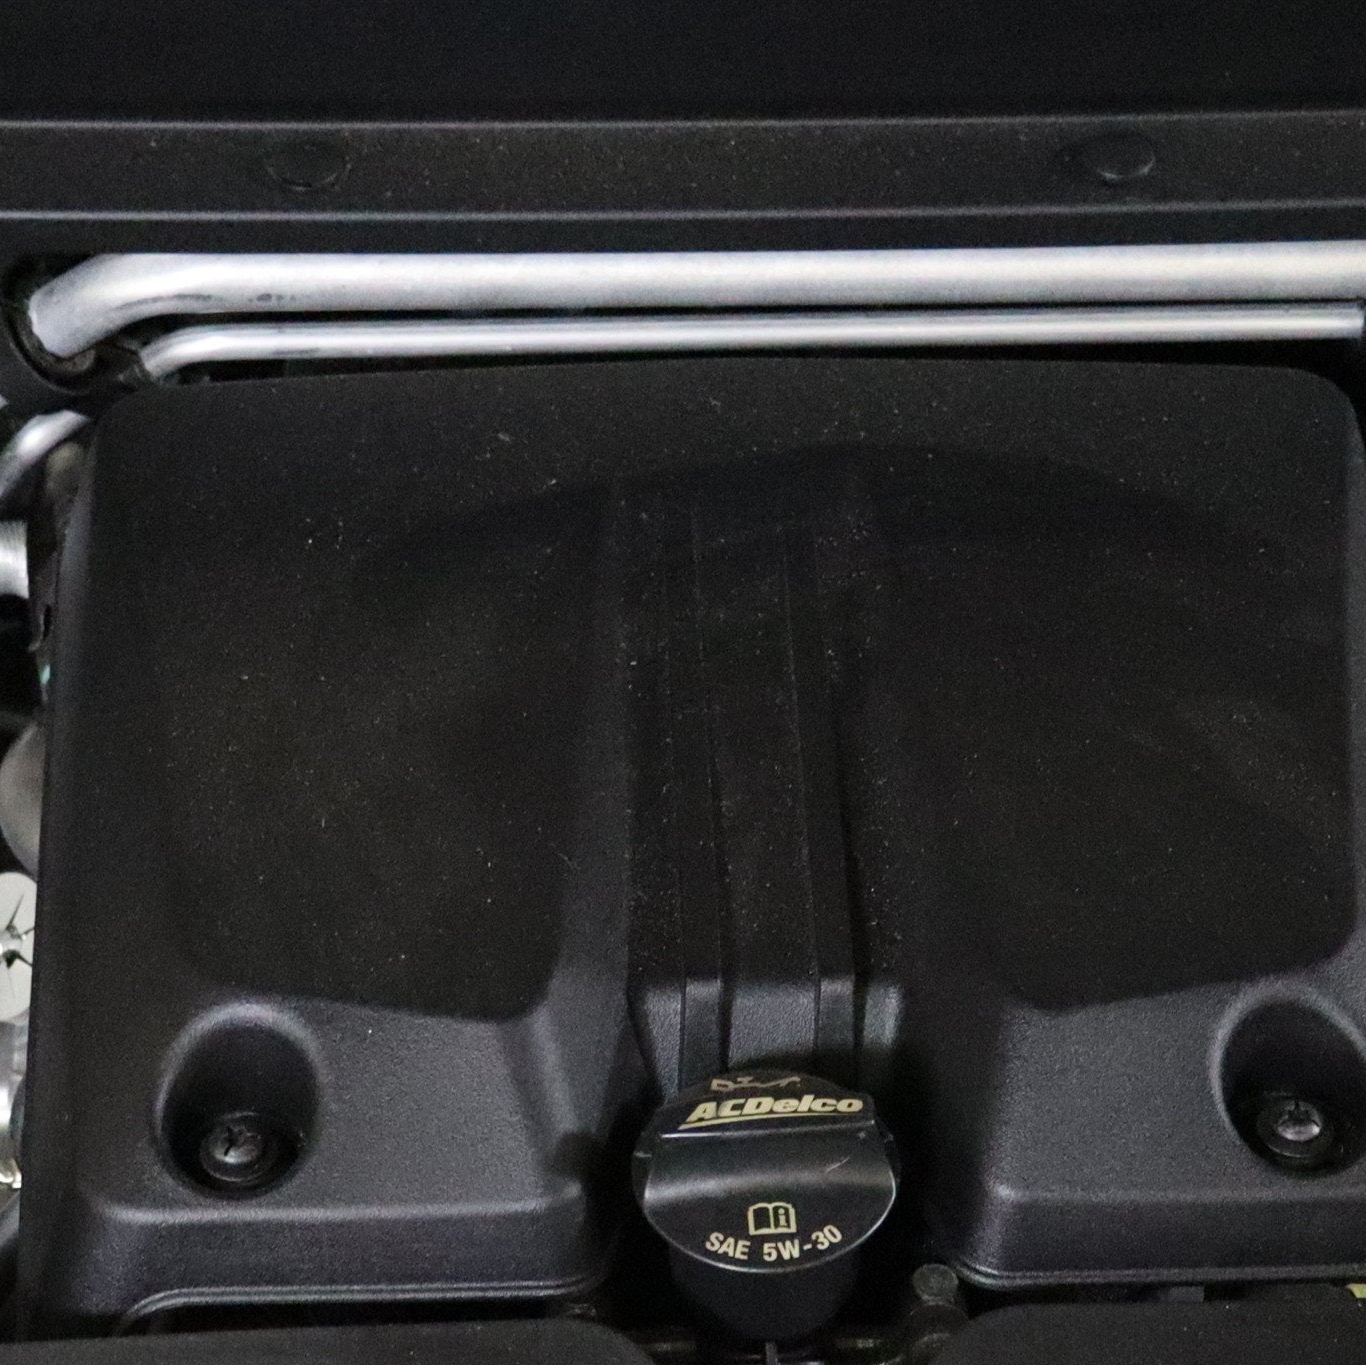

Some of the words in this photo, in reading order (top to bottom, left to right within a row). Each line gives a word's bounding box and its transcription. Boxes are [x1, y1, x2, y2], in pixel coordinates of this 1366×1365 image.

[685, 1095, 863, 1123] ACDelco
[705, 1232, 751, 1260] SAE
[763, 1224, 843, 1262] 5W-30
